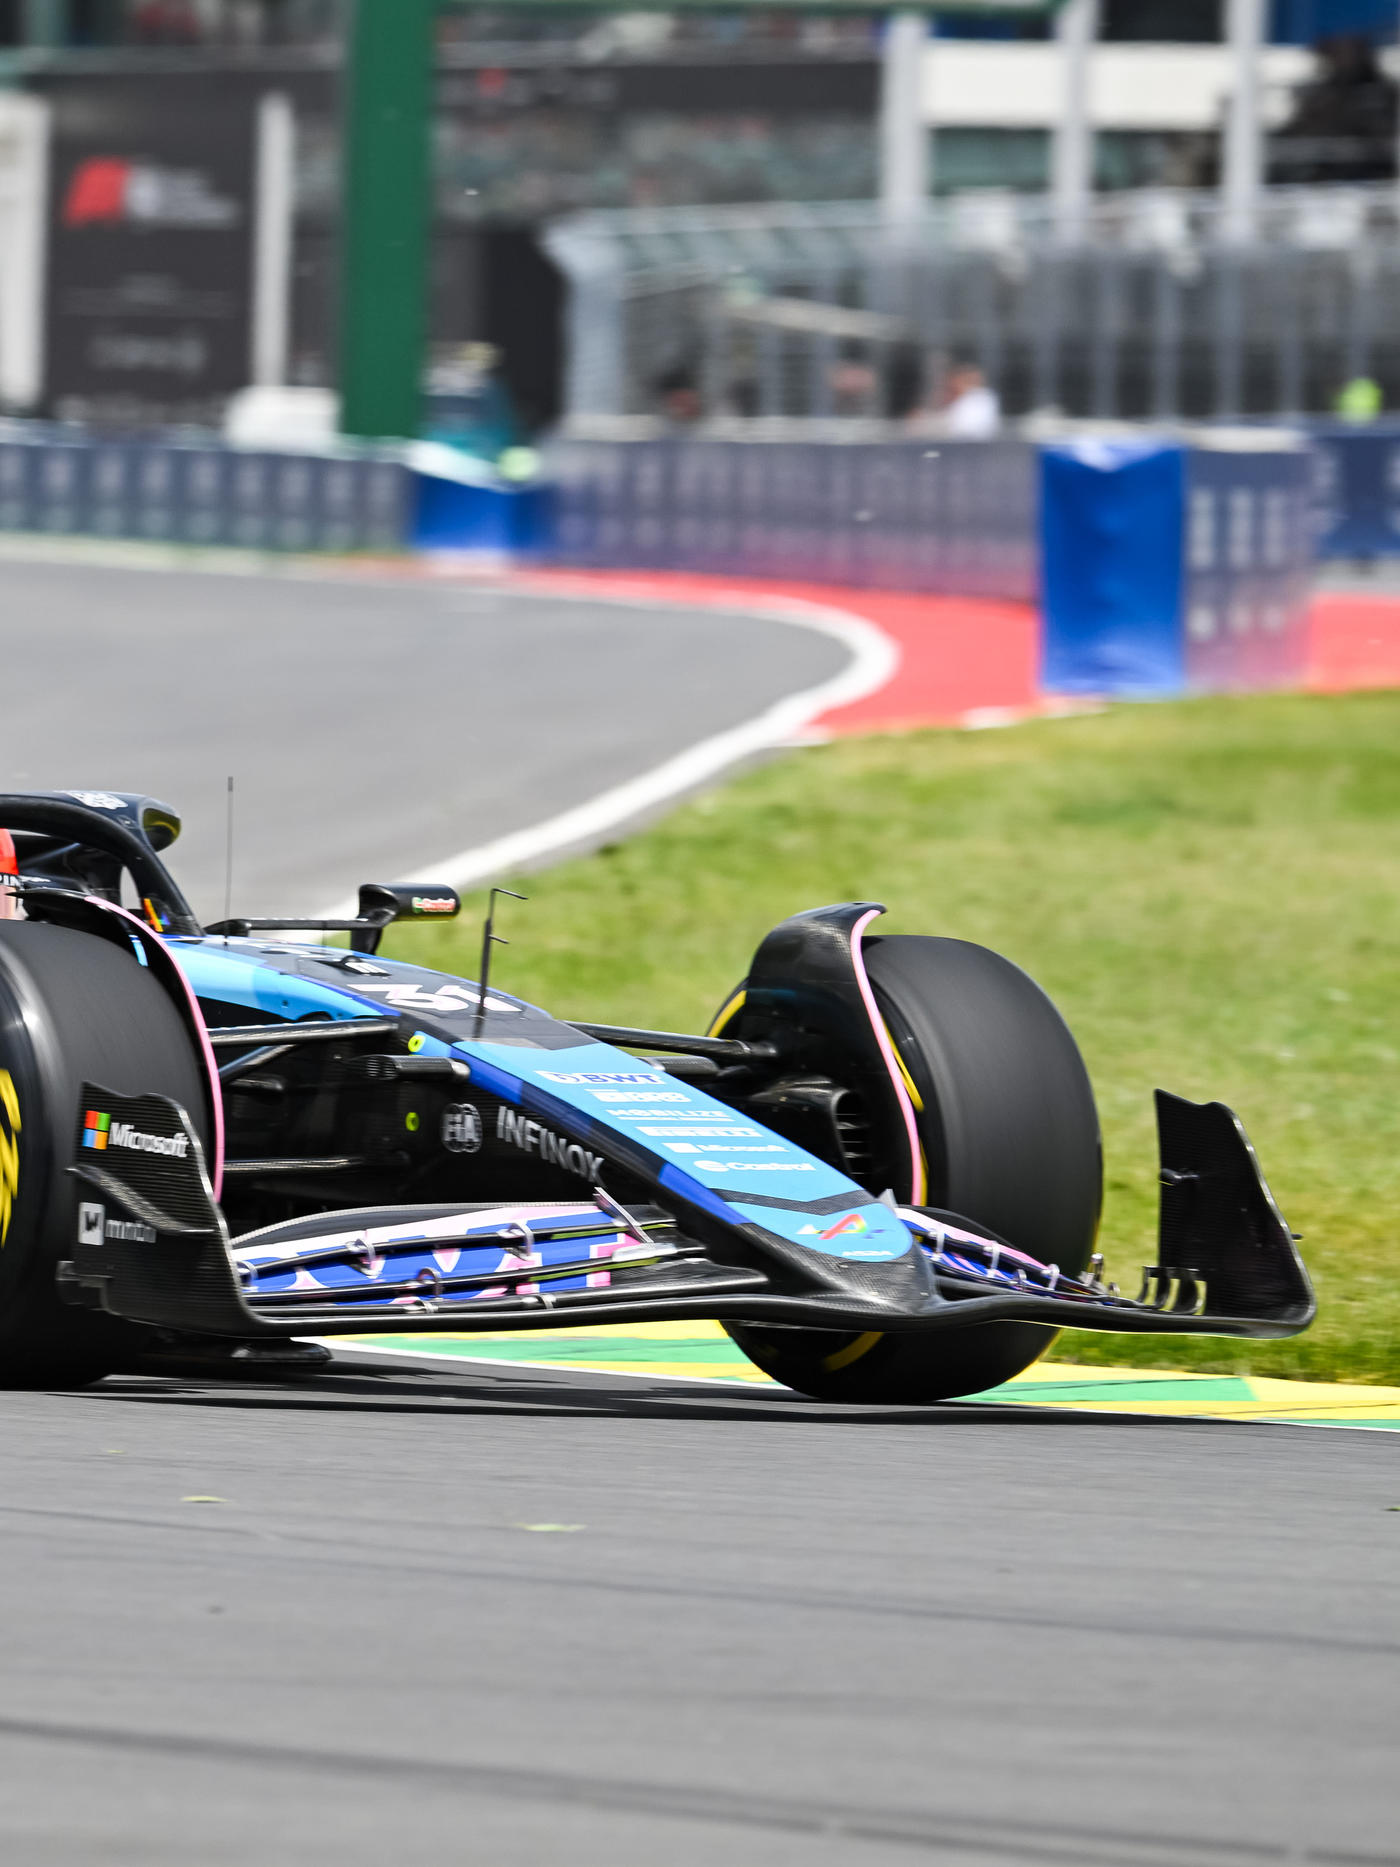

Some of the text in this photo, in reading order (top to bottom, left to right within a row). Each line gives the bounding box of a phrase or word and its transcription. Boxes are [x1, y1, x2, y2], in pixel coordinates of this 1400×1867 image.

[347, 984, 523, 1012] 31
[579, 1073, 661, 1084] BWT
[108, 1122, 190, 1158] Microsoft
[497, 1105, 607, 1187] INFINOX
